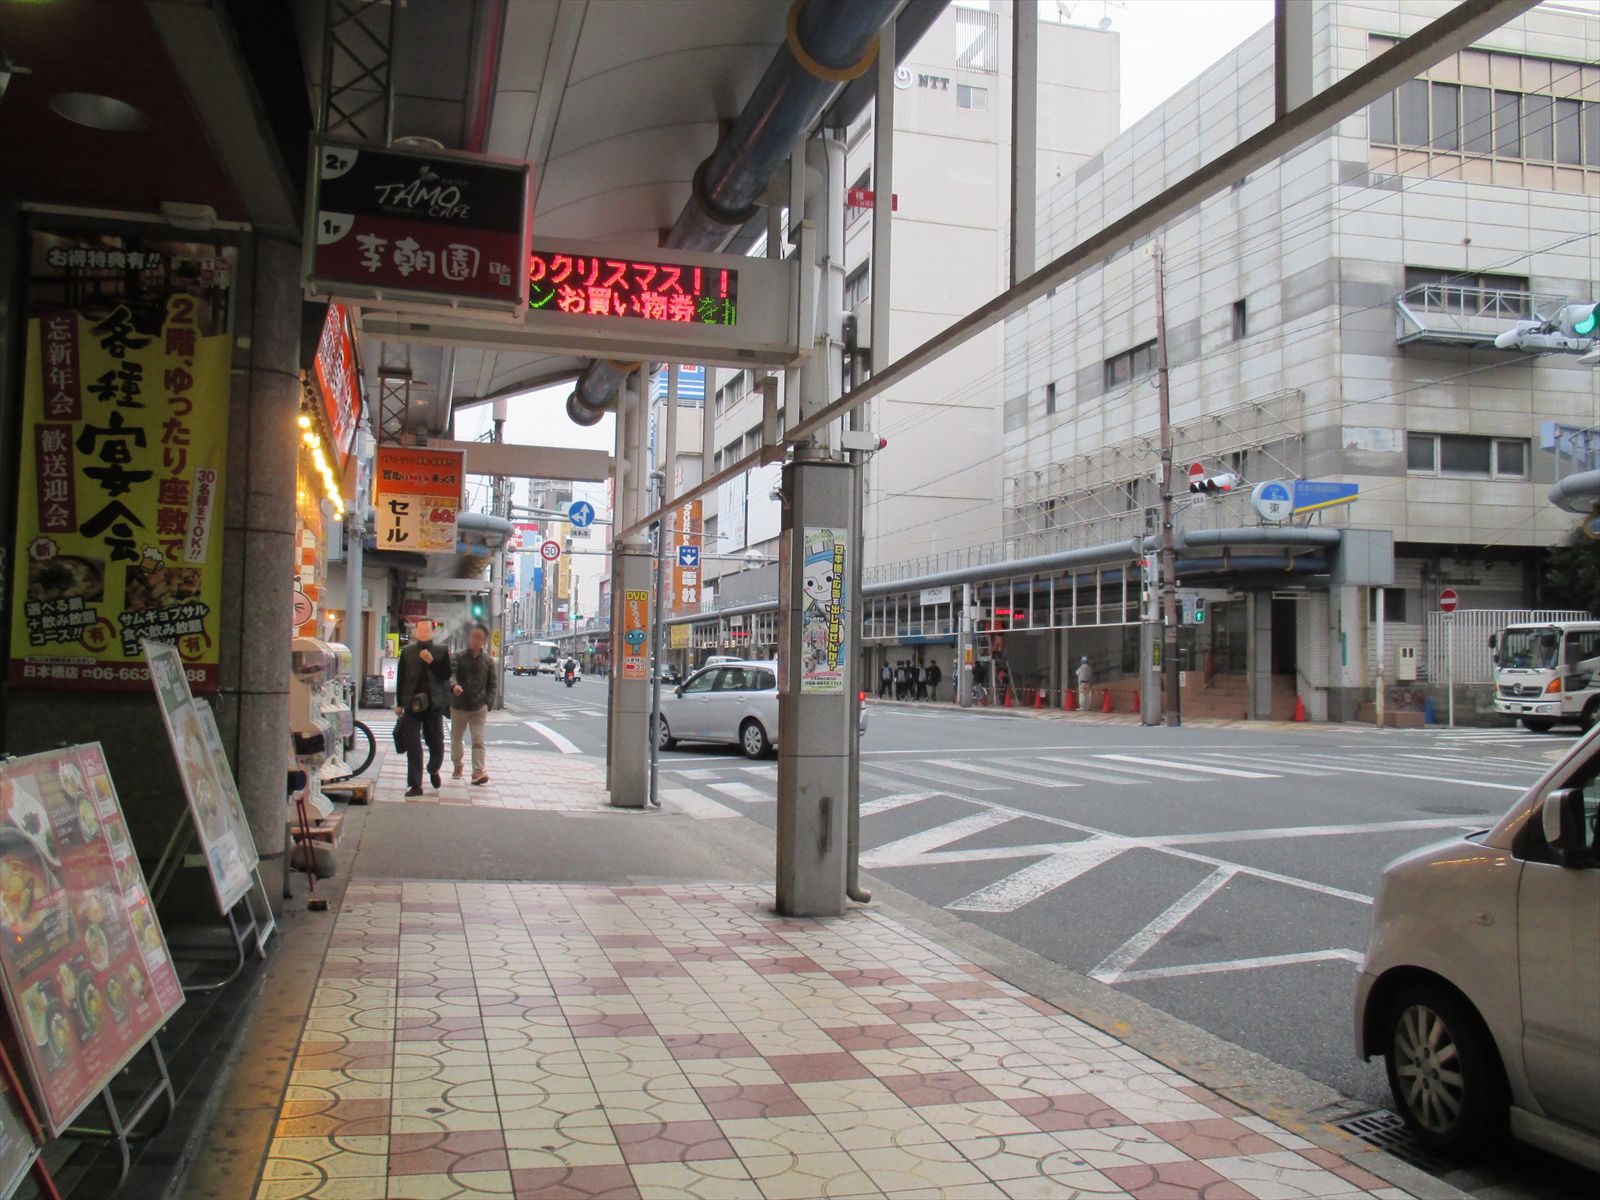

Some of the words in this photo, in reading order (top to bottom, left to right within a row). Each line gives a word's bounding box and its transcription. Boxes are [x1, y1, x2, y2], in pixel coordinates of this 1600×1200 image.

[918, 74, 949, 90] NTT
[326, 154, 348, 170] 2F
[374, 179, 461, 208] TAMO
[429, 203, 472, 219] CAFE
[323, 220, 341, 235] 1F
[355, 233, 480, 281] 李朝園
[48, 317, 75, 415] 忘新年会
[76, 303, 153, 562] 各種宴会
[386, 499, 410, 543] セール
[544, 546, 557, 556] 50
[626, 591, 648, 600] DVD
